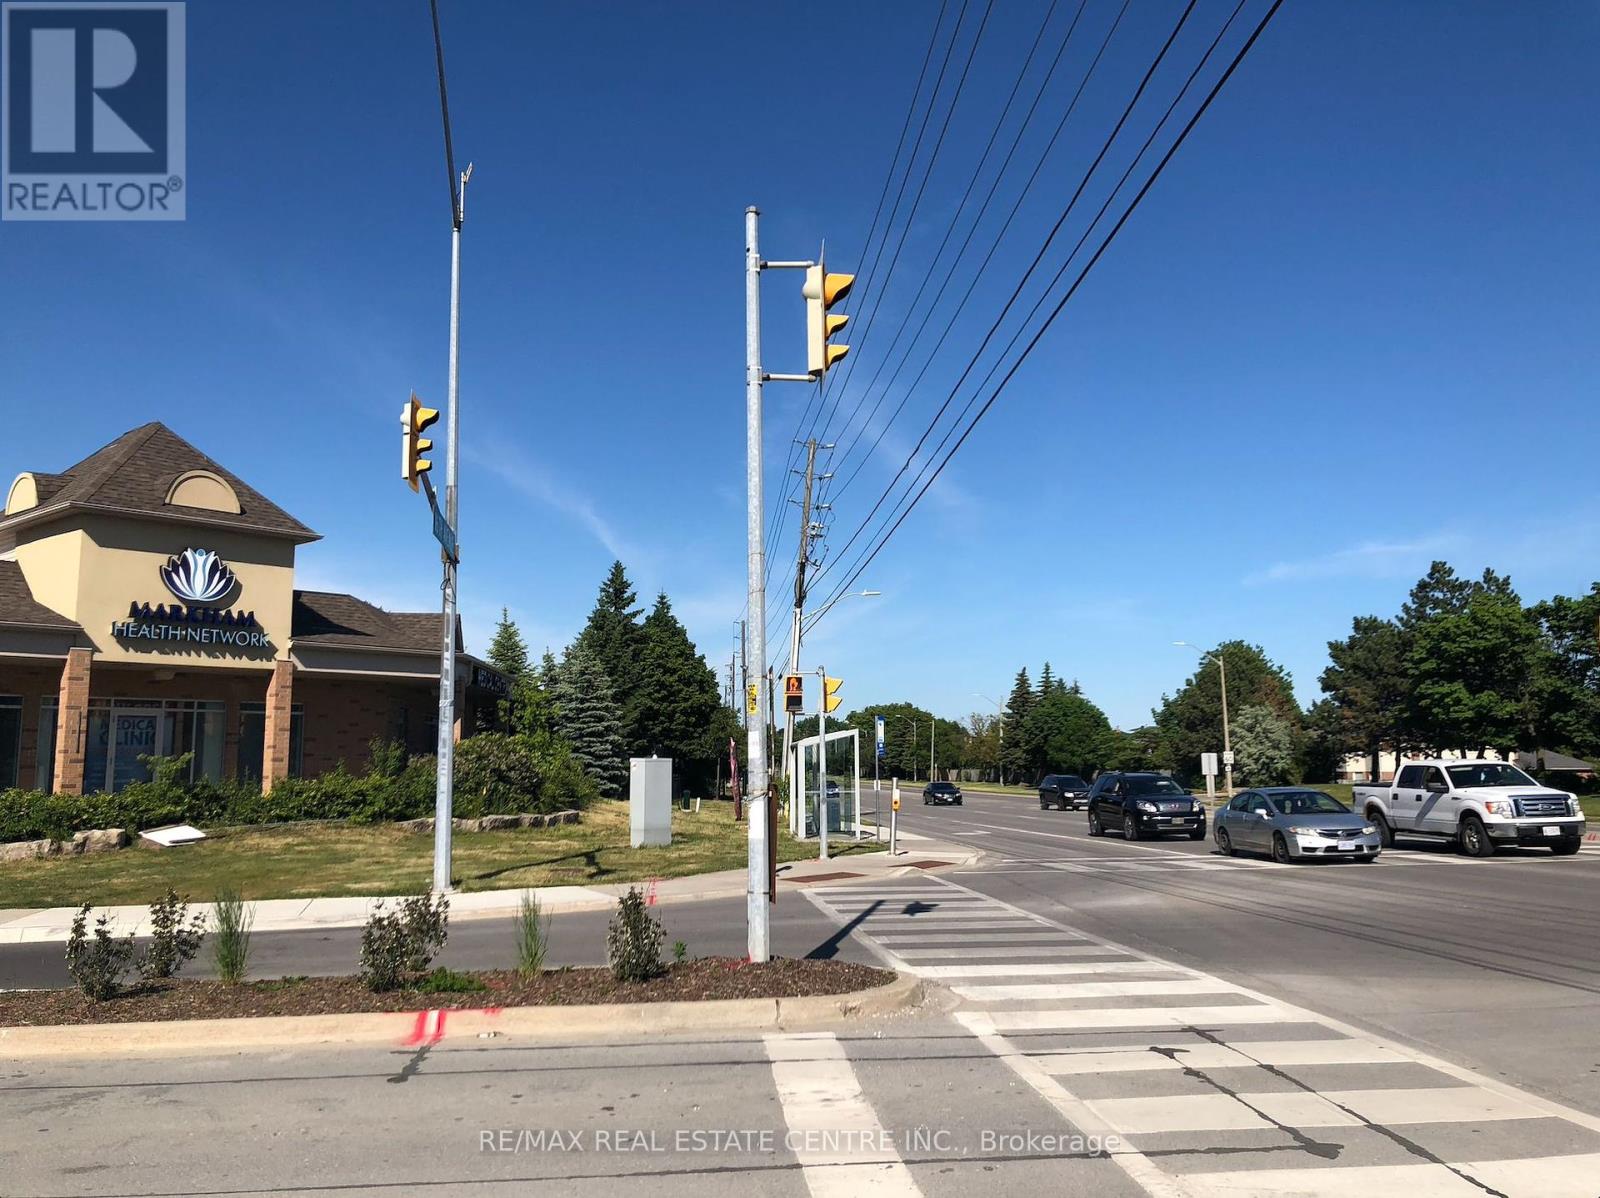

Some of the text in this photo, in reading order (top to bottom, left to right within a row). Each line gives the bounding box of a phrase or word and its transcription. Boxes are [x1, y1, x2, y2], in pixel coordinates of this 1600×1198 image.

[130, 600, 256, 627] MARKHAM
[113, 621, 269, 647] HEALTH NETWORK
[99, 719, 155, 730] MEDICA
